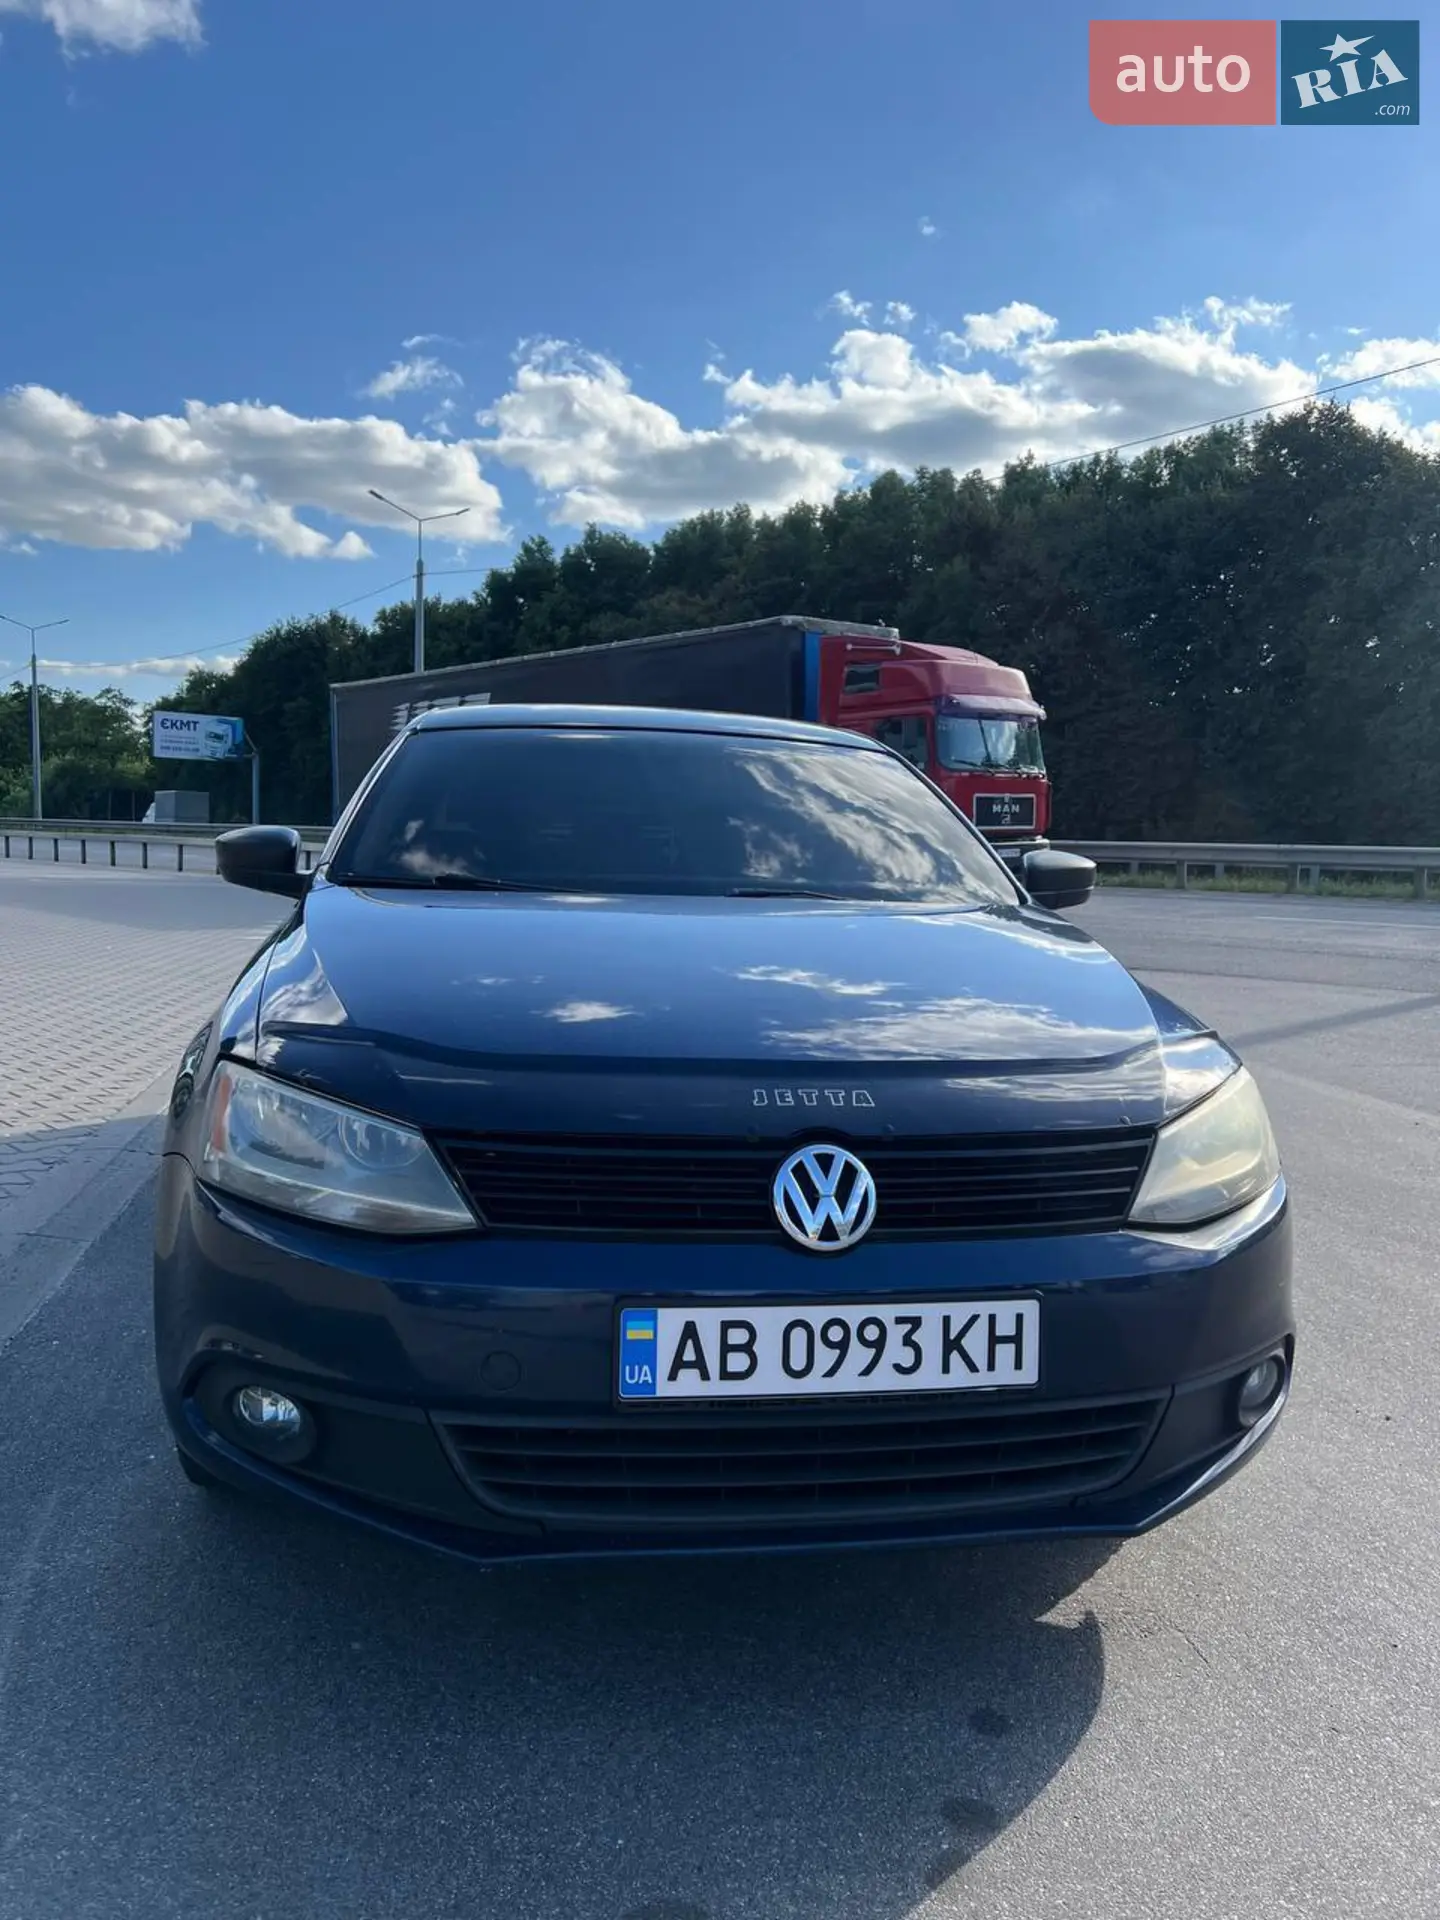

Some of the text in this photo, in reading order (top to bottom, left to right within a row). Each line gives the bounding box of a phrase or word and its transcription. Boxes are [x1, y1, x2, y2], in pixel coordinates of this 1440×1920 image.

[992, 804, 1019, 813] MAN
[753, 1088, 875, 1107] JETTA
[667, 1312, 1024, 1382] AB 0993 KH
[625, 1364, 653, 1386] UA
